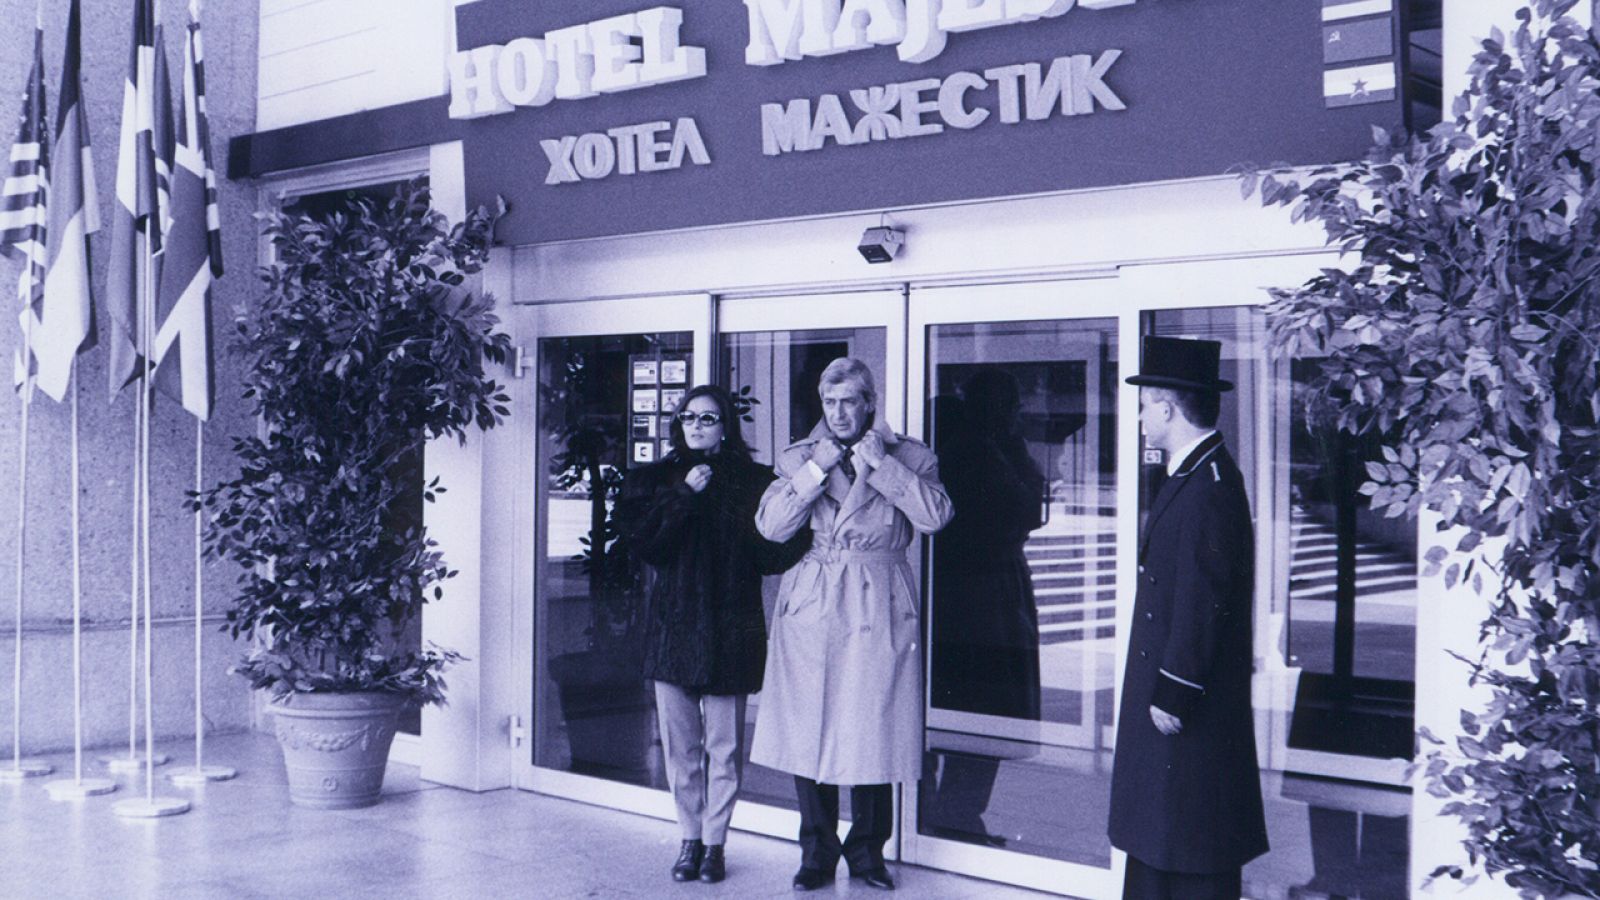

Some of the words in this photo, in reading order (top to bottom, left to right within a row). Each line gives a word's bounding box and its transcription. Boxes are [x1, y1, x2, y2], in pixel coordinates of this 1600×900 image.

[448, 6, 707, 119] HOTEL
[539, 117, 711, 184] ХОТЕЛ
[761, 49, 1127, 156] МАЖЕСТИК
